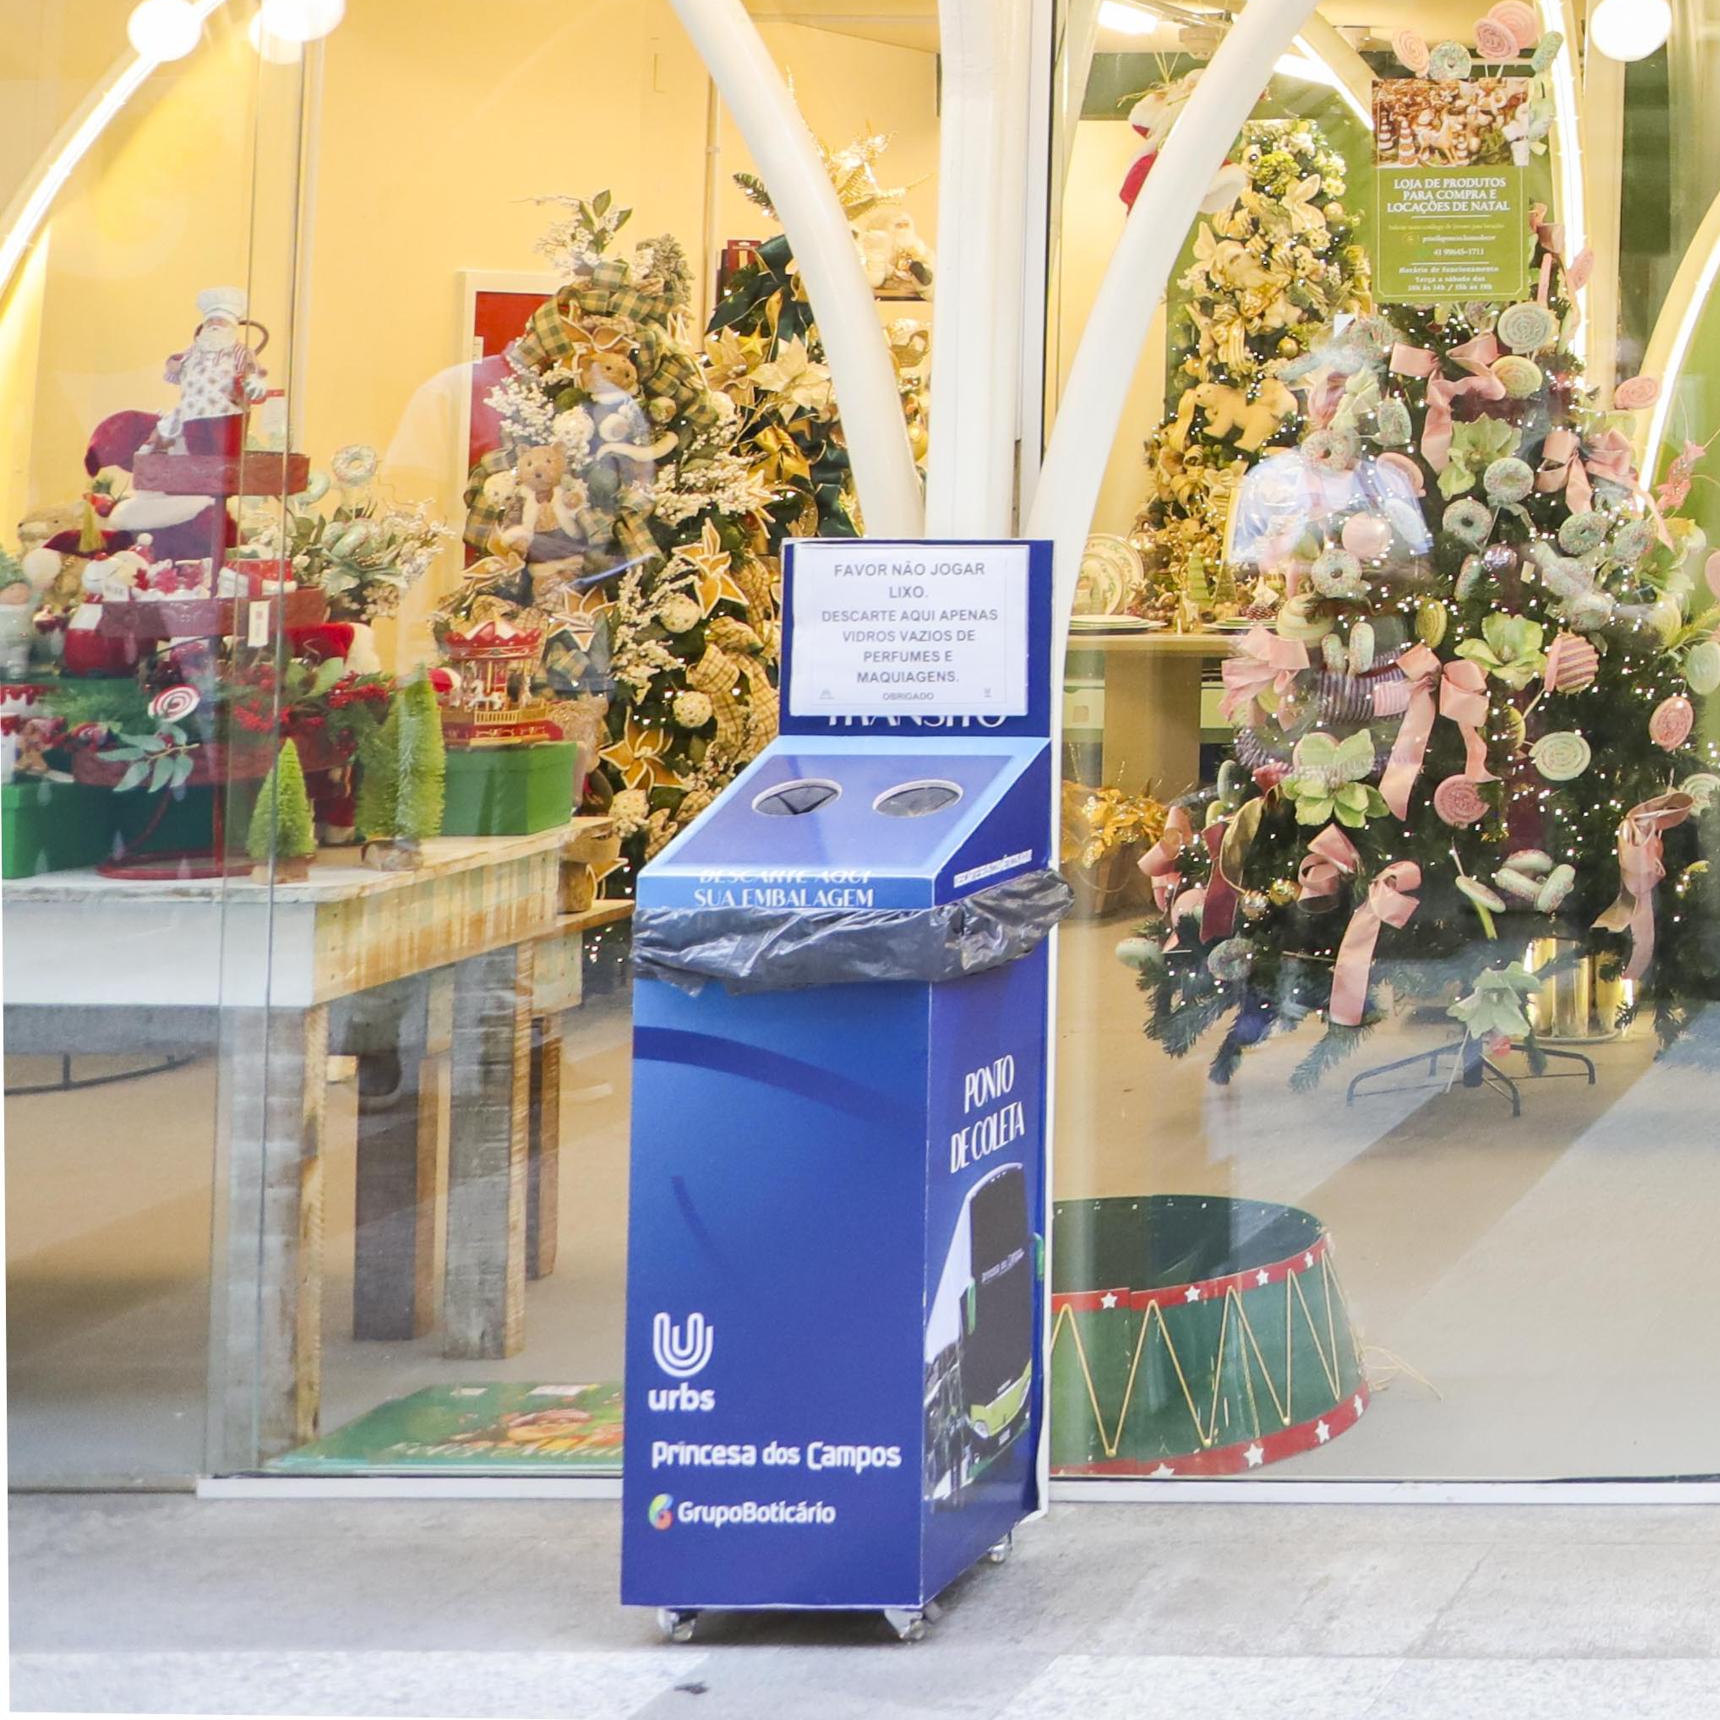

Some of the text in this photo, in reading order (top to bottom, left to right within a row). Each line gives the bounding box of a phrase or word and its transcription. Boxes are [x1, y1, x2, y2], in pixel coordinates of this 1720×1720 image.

[1394, 177, 1507, 190] LOJA DE PRODUTOS
[1403, 189, 1498, 200] PARA COMPRA E
[1387, 200, 1511, 214] LOCAÇÕES DE NATAL
[834, 561, 985, 577] FAVOR NÃO JOGAR
[889, 586, 929, 599] LIXO.
[822, 608, 998, 623] DESCARTE AQUI APENAS
[842, 629, 976, 643] VIDROS VAZIOS DE
[863, 650, 953, 663] PERFUMES E
[857, 671, 959, 684] MAQUIAGENS.
[883, 691, 935, 701] OBRIGADO
[693, 887, 874, 908] SUA EMBALAGEM
[964, 1054, 1015, 1114] PONTO
[950, 1101, 1025, 1174] DE COLETA
[648, 1383, 716, 1412] urbs
[652, 1440, 757, 1469] Princesa
[762, 1440, 801, 1466] dos
[806, 1440, 902, 1474] Campos
[677, 1500, 837, 1529] GrupoBoticário
